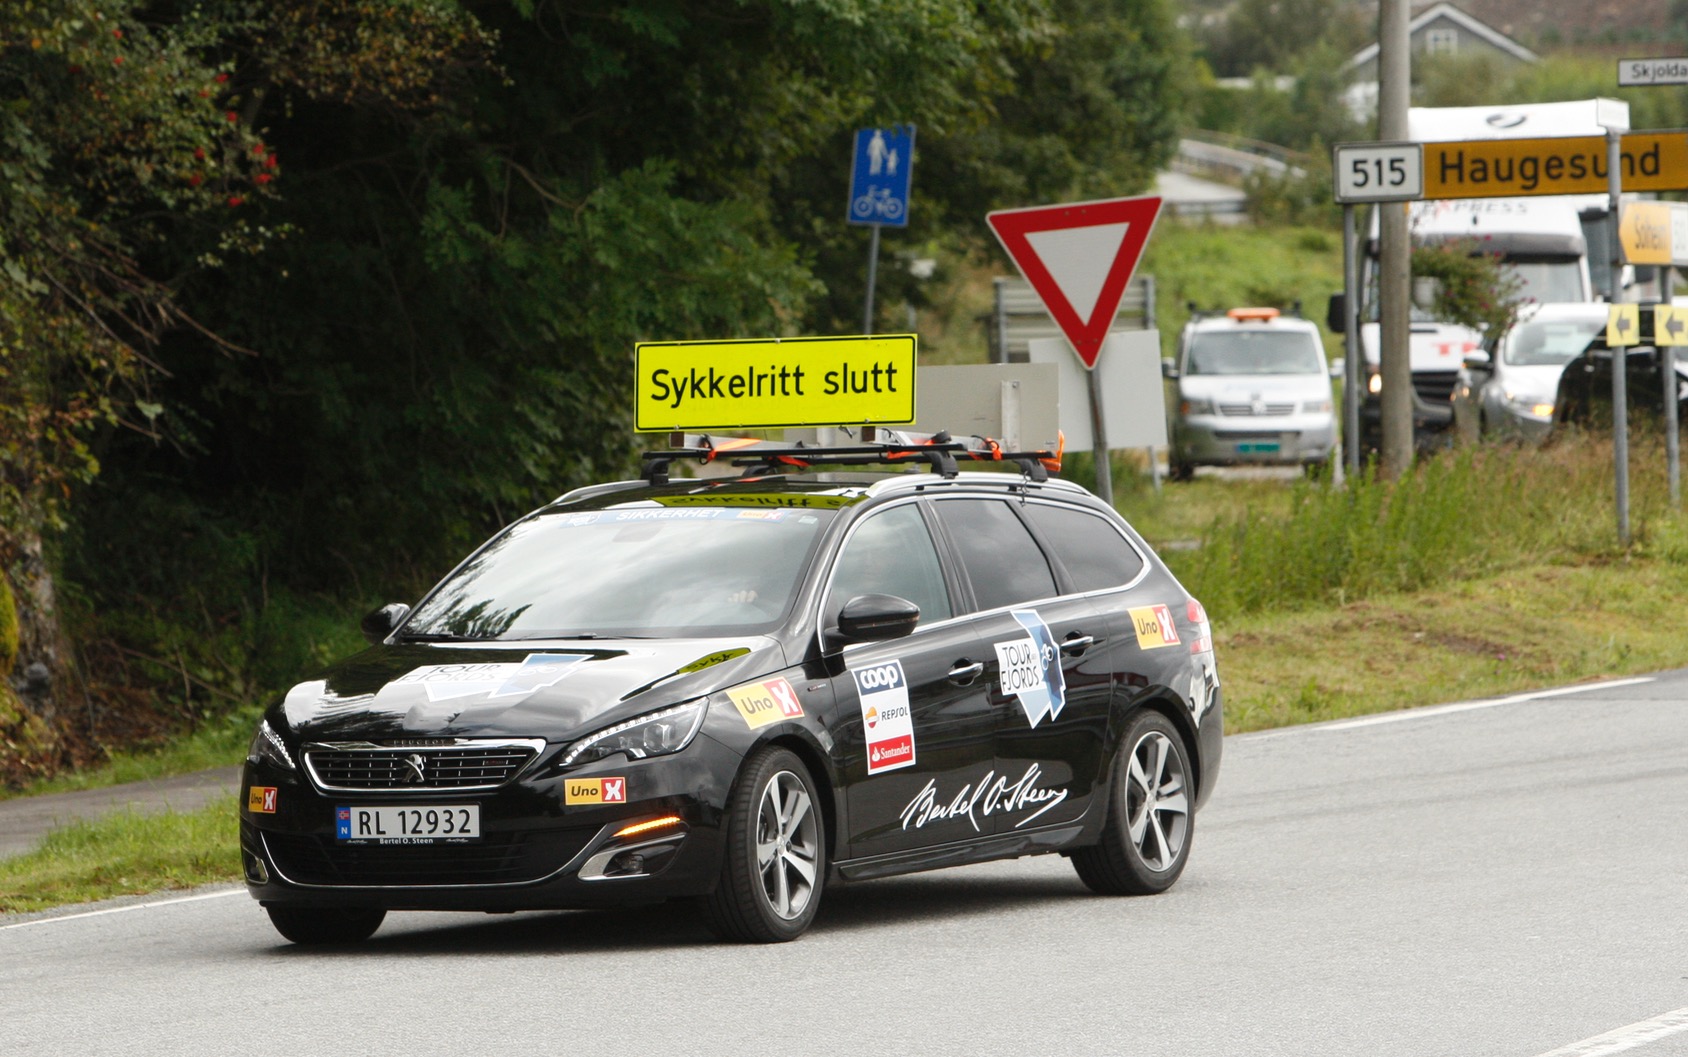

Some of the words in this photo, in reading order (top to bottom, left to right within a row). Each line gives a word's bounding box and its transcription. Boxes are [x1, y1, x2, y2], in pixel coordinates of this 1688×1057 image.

[1352, 158, 1406, 188] 515
[1439, 143, 1660, 191] Haugesund
[651, 364, 805, 409] Sykkelritt
[823, 361, 898, 395] slutt
[616, 509, 726, 521] SIKKERHET
[1137, 618, 1158, 636] Uno
[1002, 643, 1032, 668] TOUR
[860, 665, 899, 689] coop
[1001, 665, 1040, 691] FJORDS
[741, 697, 774, 715] Uno
[881, 706, 909, 721] REPSOL
[880, 742, 911, 760] Santander
[250, 793, 263, 804] Uno
[571, 785, 599, 797] Uno
[899, 770, 995, 832] Bertel
[358, 811, 387, 835] RL
[397, 809, 472, 835] 12932
